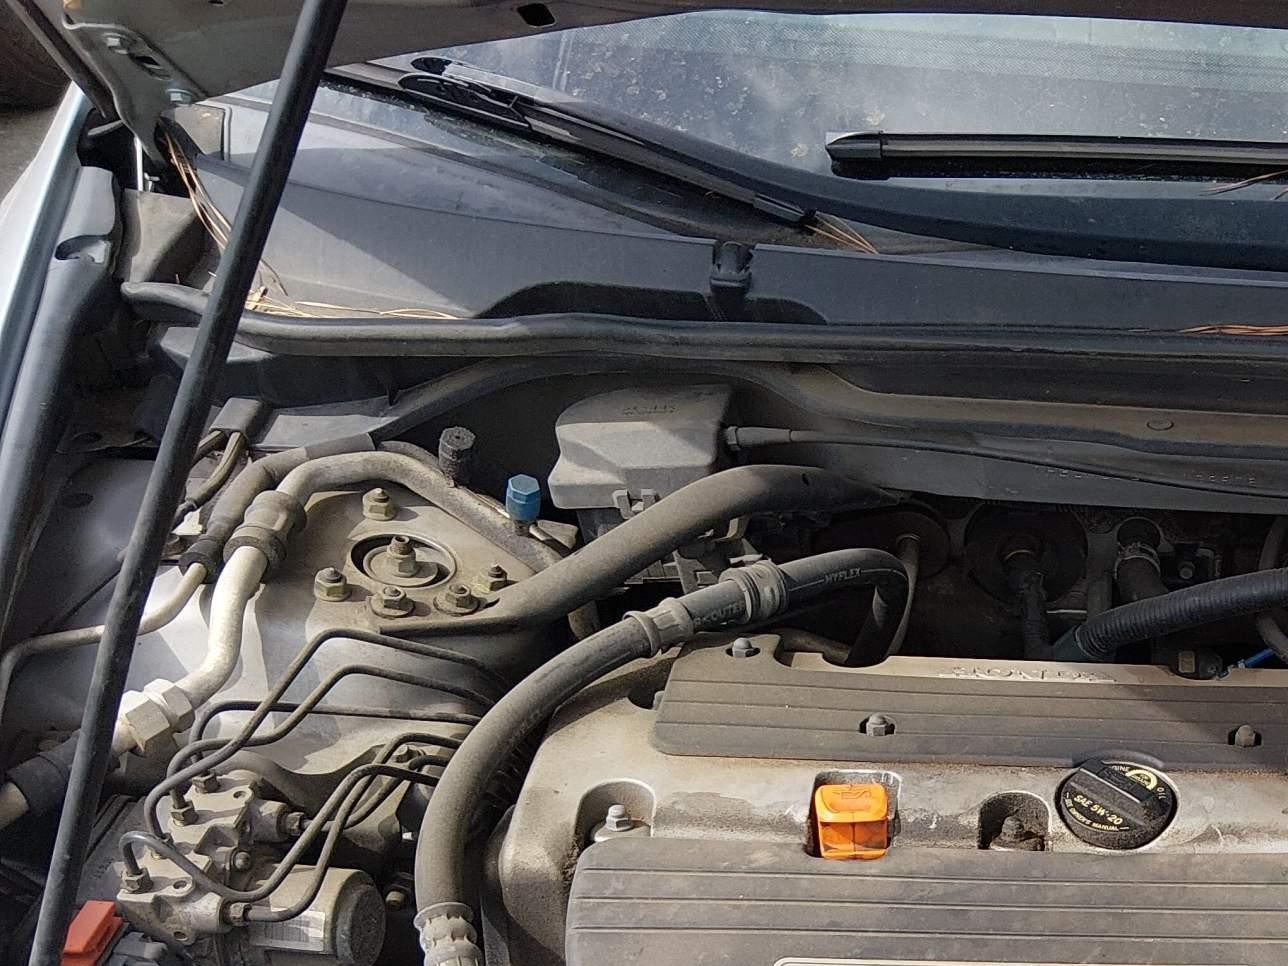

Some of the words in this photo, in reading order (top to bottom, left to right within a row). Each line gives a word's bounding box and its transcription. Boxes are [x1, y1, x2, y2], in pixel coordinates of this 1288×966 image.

[1073, 794, 1093, 808] SAE
[1091, 804, 1123, 825] 5W-20
[1092, 822, 1119, 832] MANUAL
